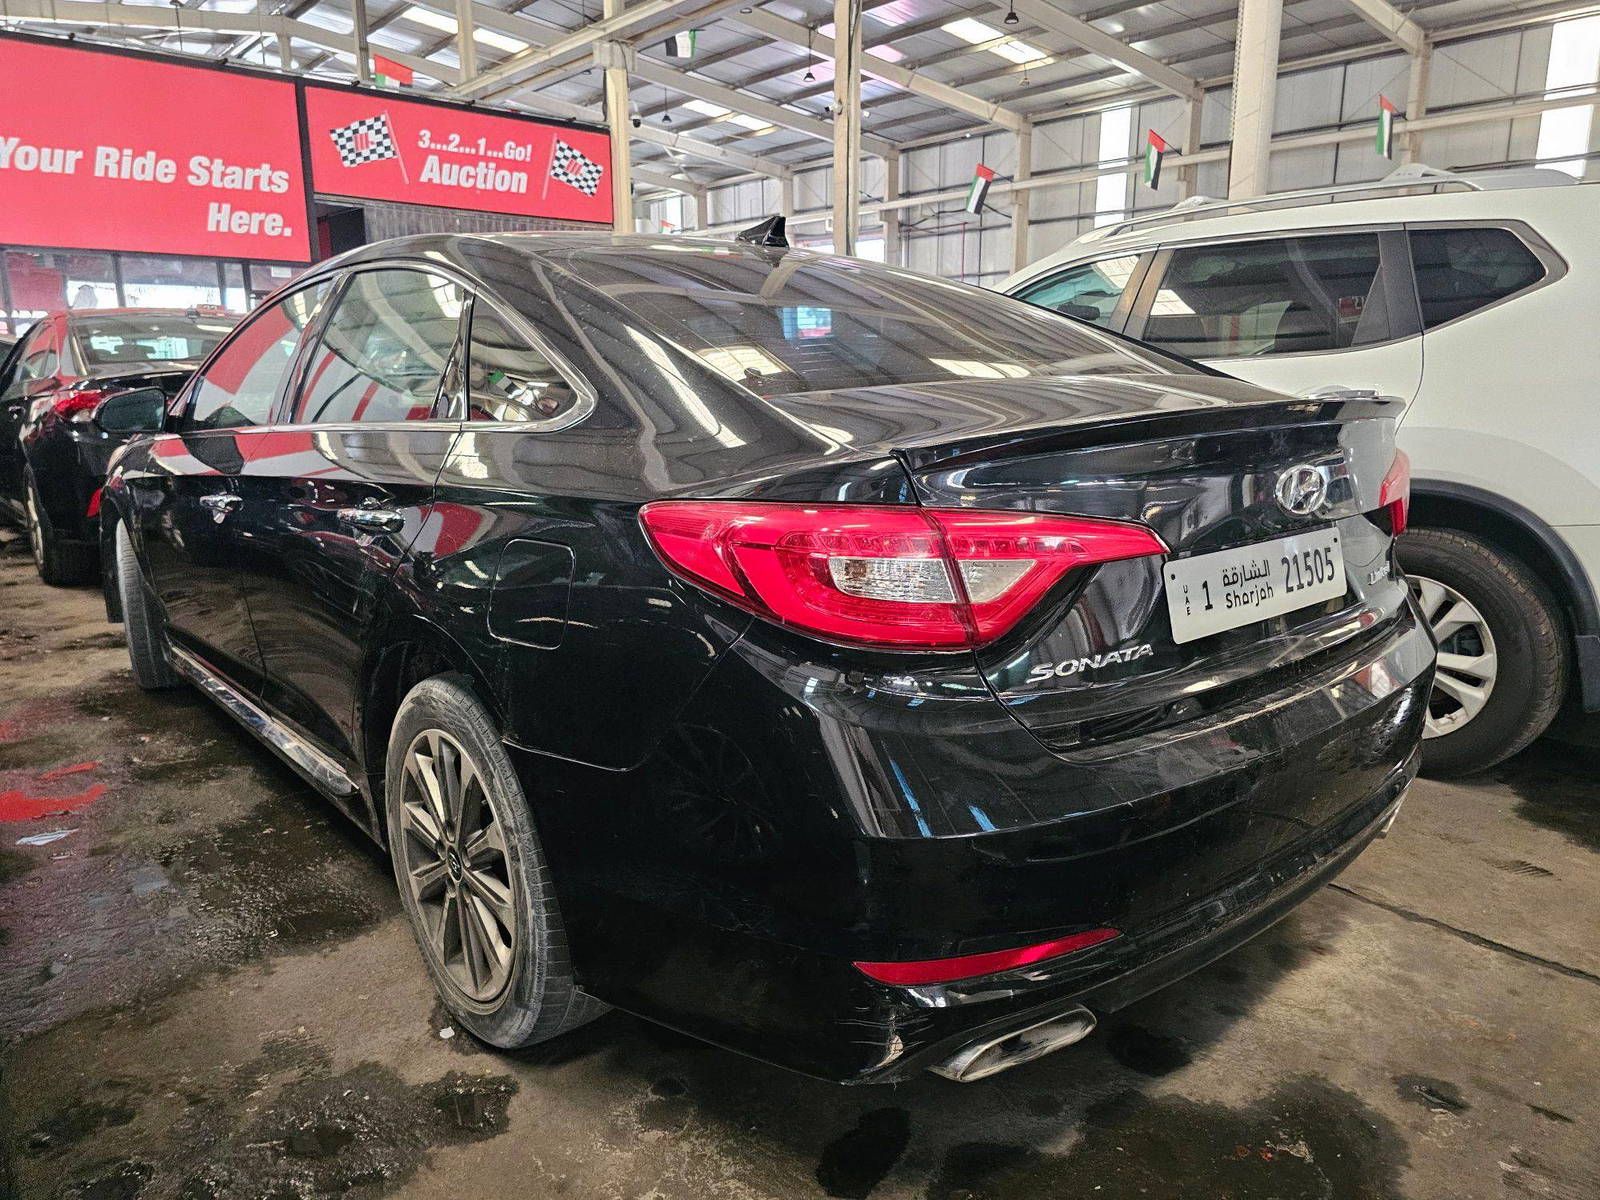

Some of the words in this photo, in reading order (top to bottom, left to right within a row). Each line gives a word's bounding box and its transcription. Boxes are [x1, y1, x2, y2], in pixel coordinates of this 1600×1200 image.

[417, 129, 532, 162] 3...2...1...Go!
[0, 136, 83, 174] Your
[94, 146, 177, 183] Ride
[187, 155, 289, 193] Starts
[420, 155, 528, 193] Auction
[207, 202, 292, 236] Here.
[1222, 560, 1271, 588] الشارقة
[1281, 547, 1335, 594] 21505
[1202, 580, 1214, 611] 1
[1225, 582, 1273, 609] Sharjah
[1026, 643, 1154, 684] SONATA
